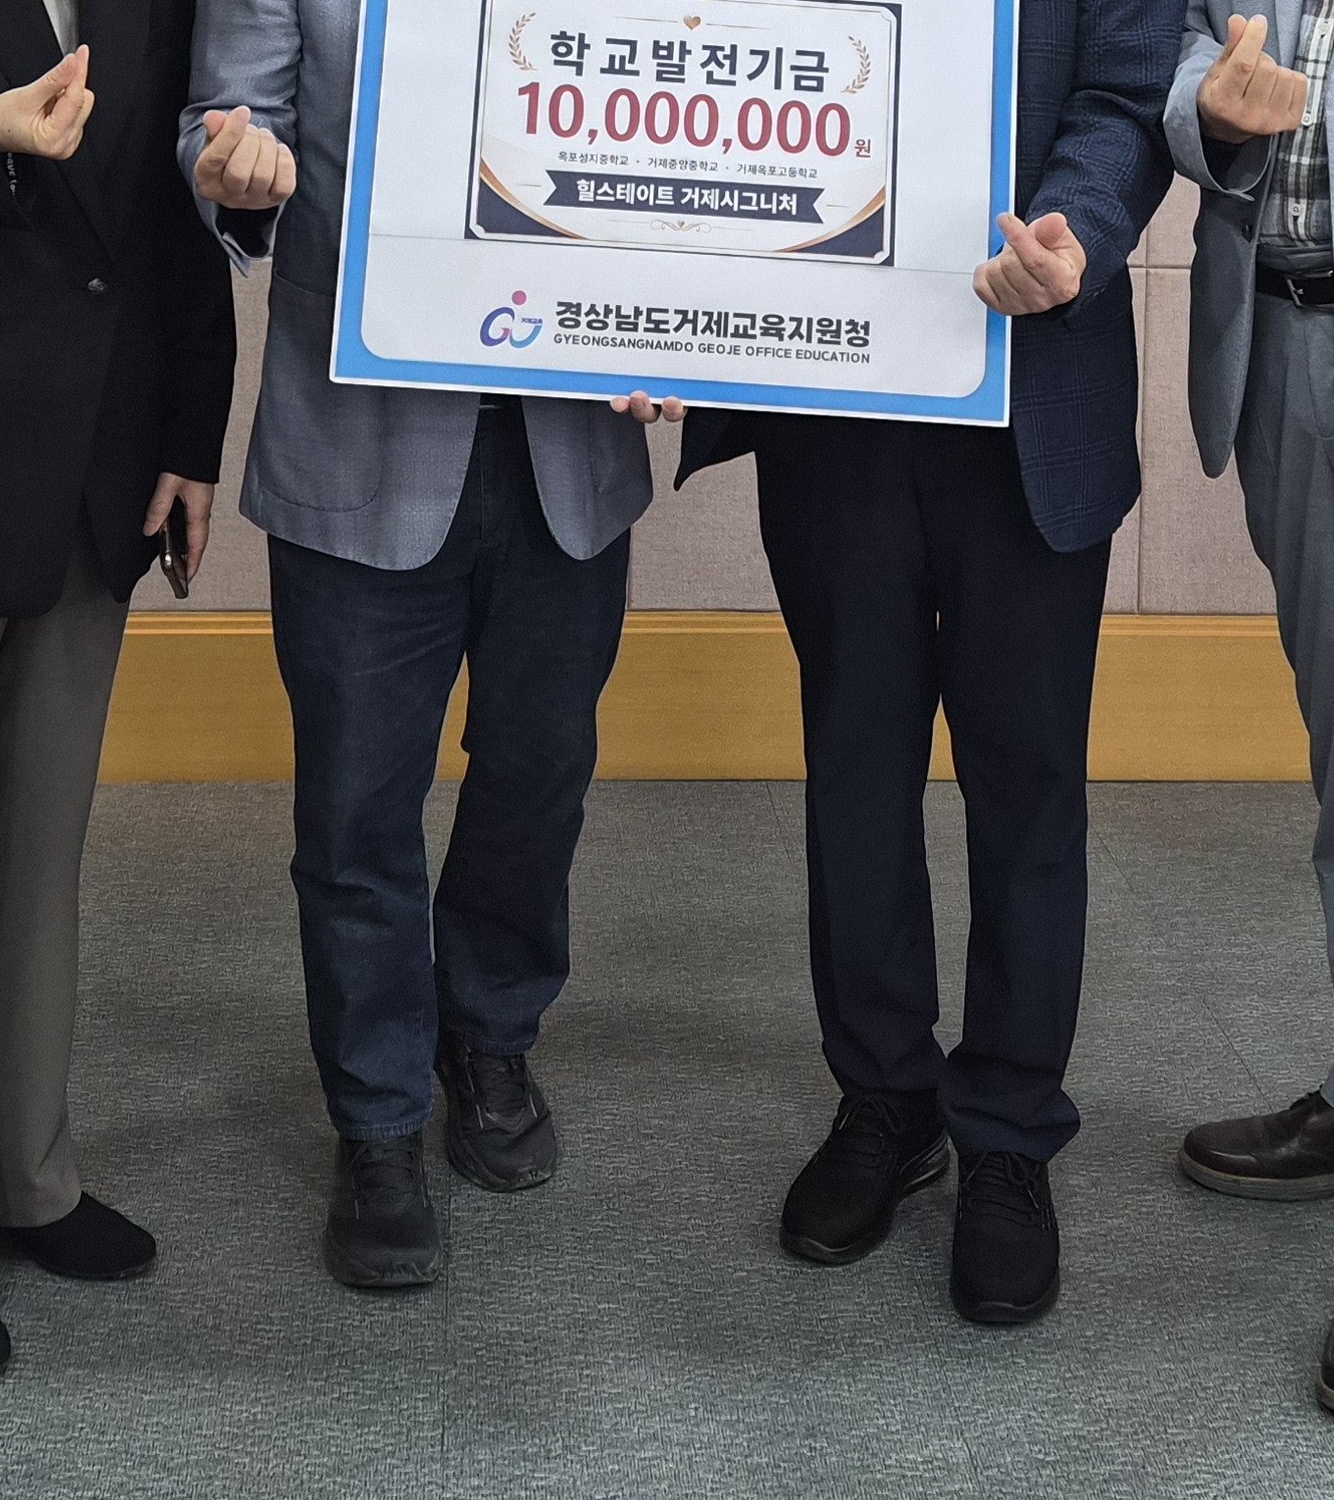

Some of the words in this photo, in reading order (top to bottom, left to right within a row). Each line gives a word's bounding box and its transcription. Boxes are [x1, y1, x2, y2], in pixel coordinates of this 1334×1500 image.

[549, 30, 830, 93] 학교발전기금
[517, 80, 872, 158] 10,000,000원
[557, 150, 629, 166] 옥포성지중학교
[647, 156, 719, 172] 거제중앙중학교
[736, 163, 818, 179] 거제옥포고등학교
[575, 178, 675, 206] 힐스테이트
[680, 186, 798, 215] 거제시그니처
[554, 300, 872, 349] 경상남도거제교육지원청
[553, 333, 694, 353] GYEONGSANGNAMDO
[697, 342, 742, 356] GEOJE
[745, 346, 792, 360] OFFICE
[795, 348, 871, 365] EDUCATION
